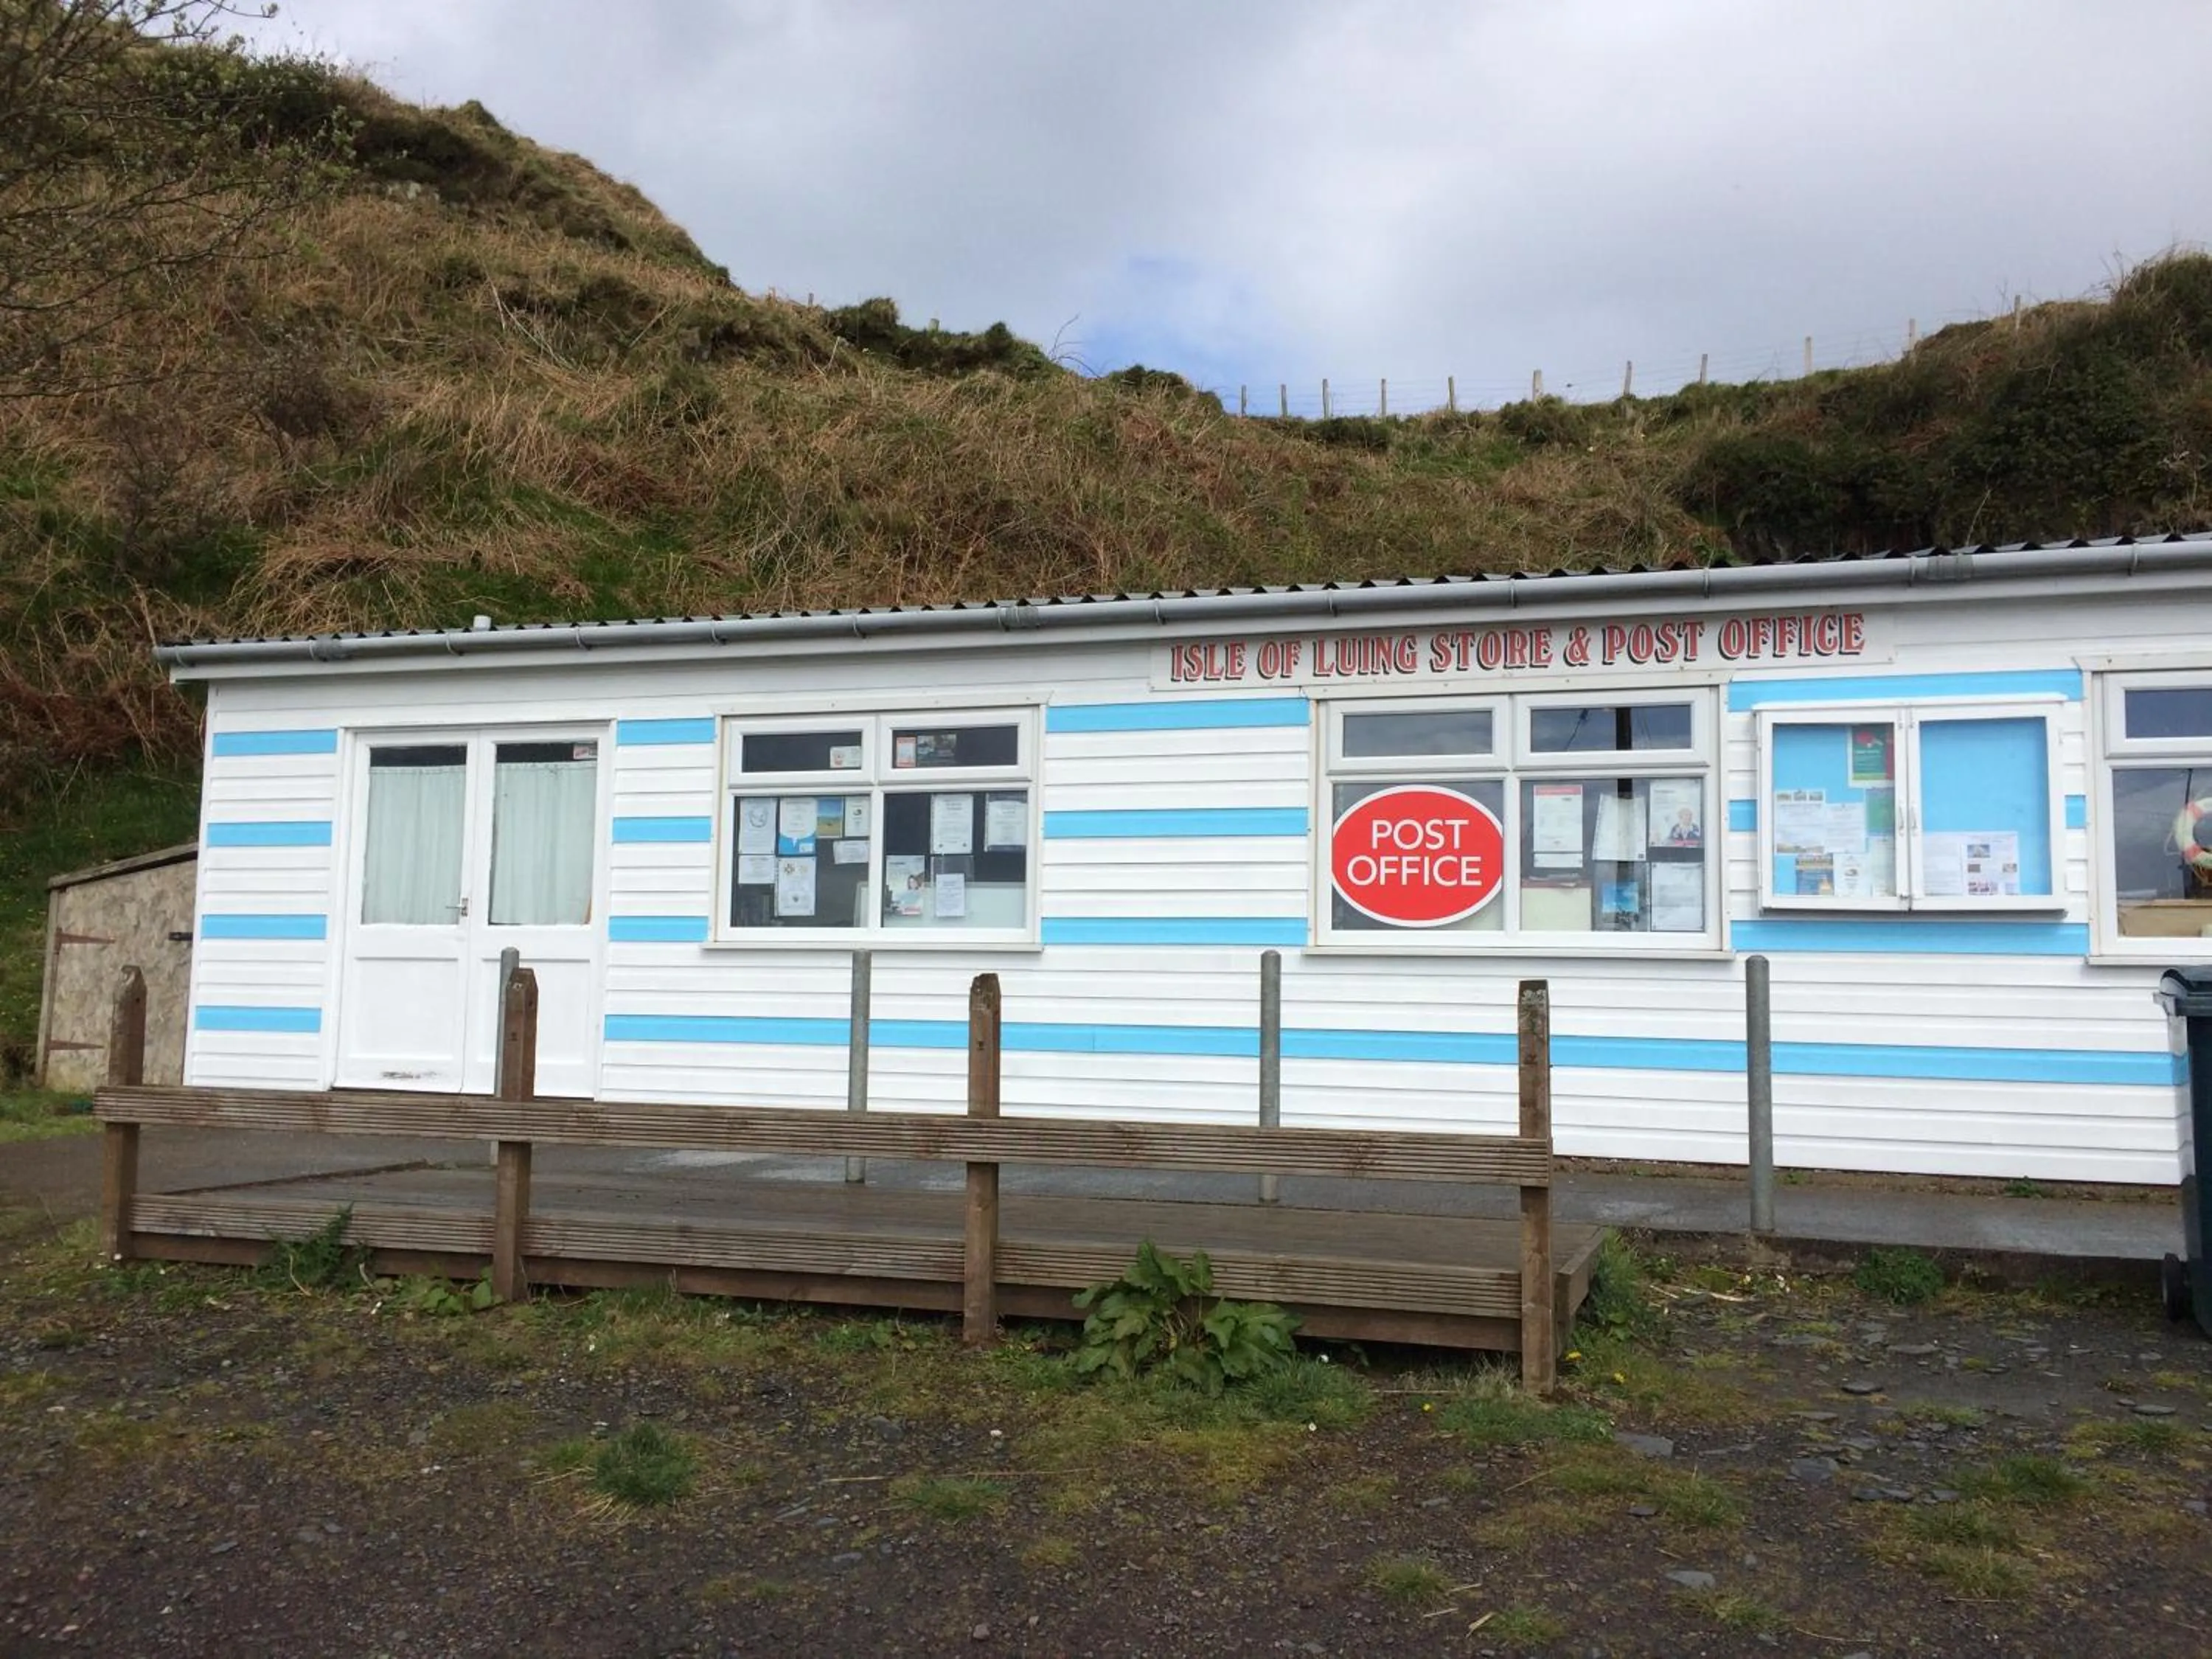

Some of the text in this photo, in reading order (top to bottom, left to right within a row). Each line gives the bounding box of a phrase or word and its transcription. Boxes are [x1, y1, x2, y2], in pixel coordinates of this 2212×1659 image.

[1171, 612, 1865, 681] ISLE OF LUING STORE & POST OFFICE
[1371, 818, 1470, 850] POST
[1346, 855, 1483, 887] OFFICE
